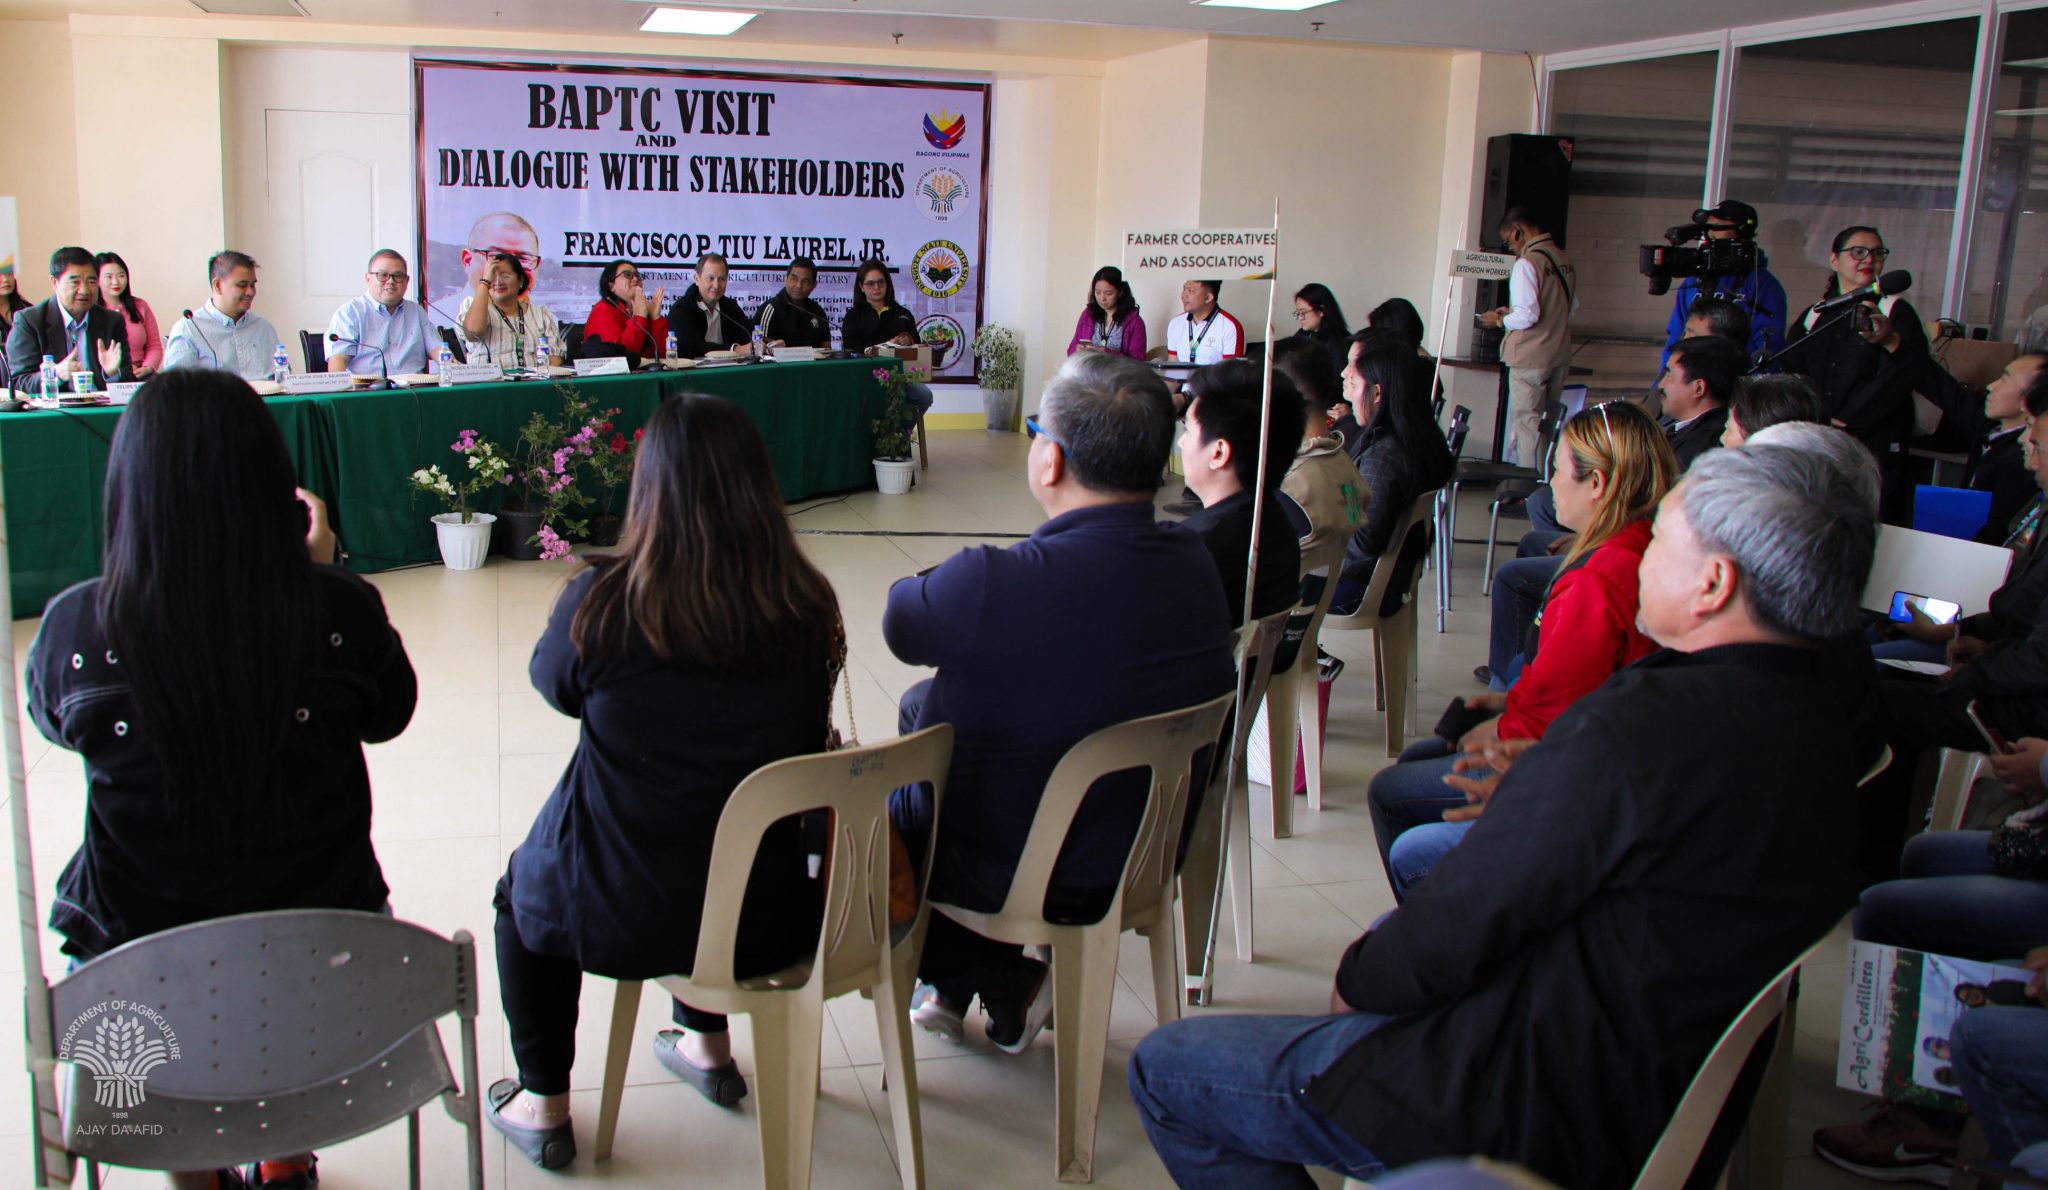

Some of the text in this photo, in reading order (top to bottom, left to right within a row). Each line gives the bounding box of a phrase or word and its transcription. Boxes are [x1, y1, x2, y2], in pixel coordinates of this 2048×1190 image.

[527, 83, 775, 136] BAPTC VISIT
[635, 134, 676, 147] AND
[438, 148, 905, 199] DIALOGUE WITH STAKEHOLDERS
[915, 167, 938, 196] DEPARTMENT
[948, 168, 970, 199] AGRICULTURE
[1127, 233, 1277, 246] FARMER COOPERATIVES
[564, 231, 692, 259] FRANCISCO
[718, 234, 756, 260] TIU
[763, 235, 856, 265] LAUREL,
[859, 238, 890, 262] JR.
[1139, 255, 1264, 267] AND ASSOCIATIONS
[1465, 253, 1505, 264] AGRICULTURAL
[642, 271, 691, 281] RTMENT
[1456, 265, 1484, 274] EXTENSION
